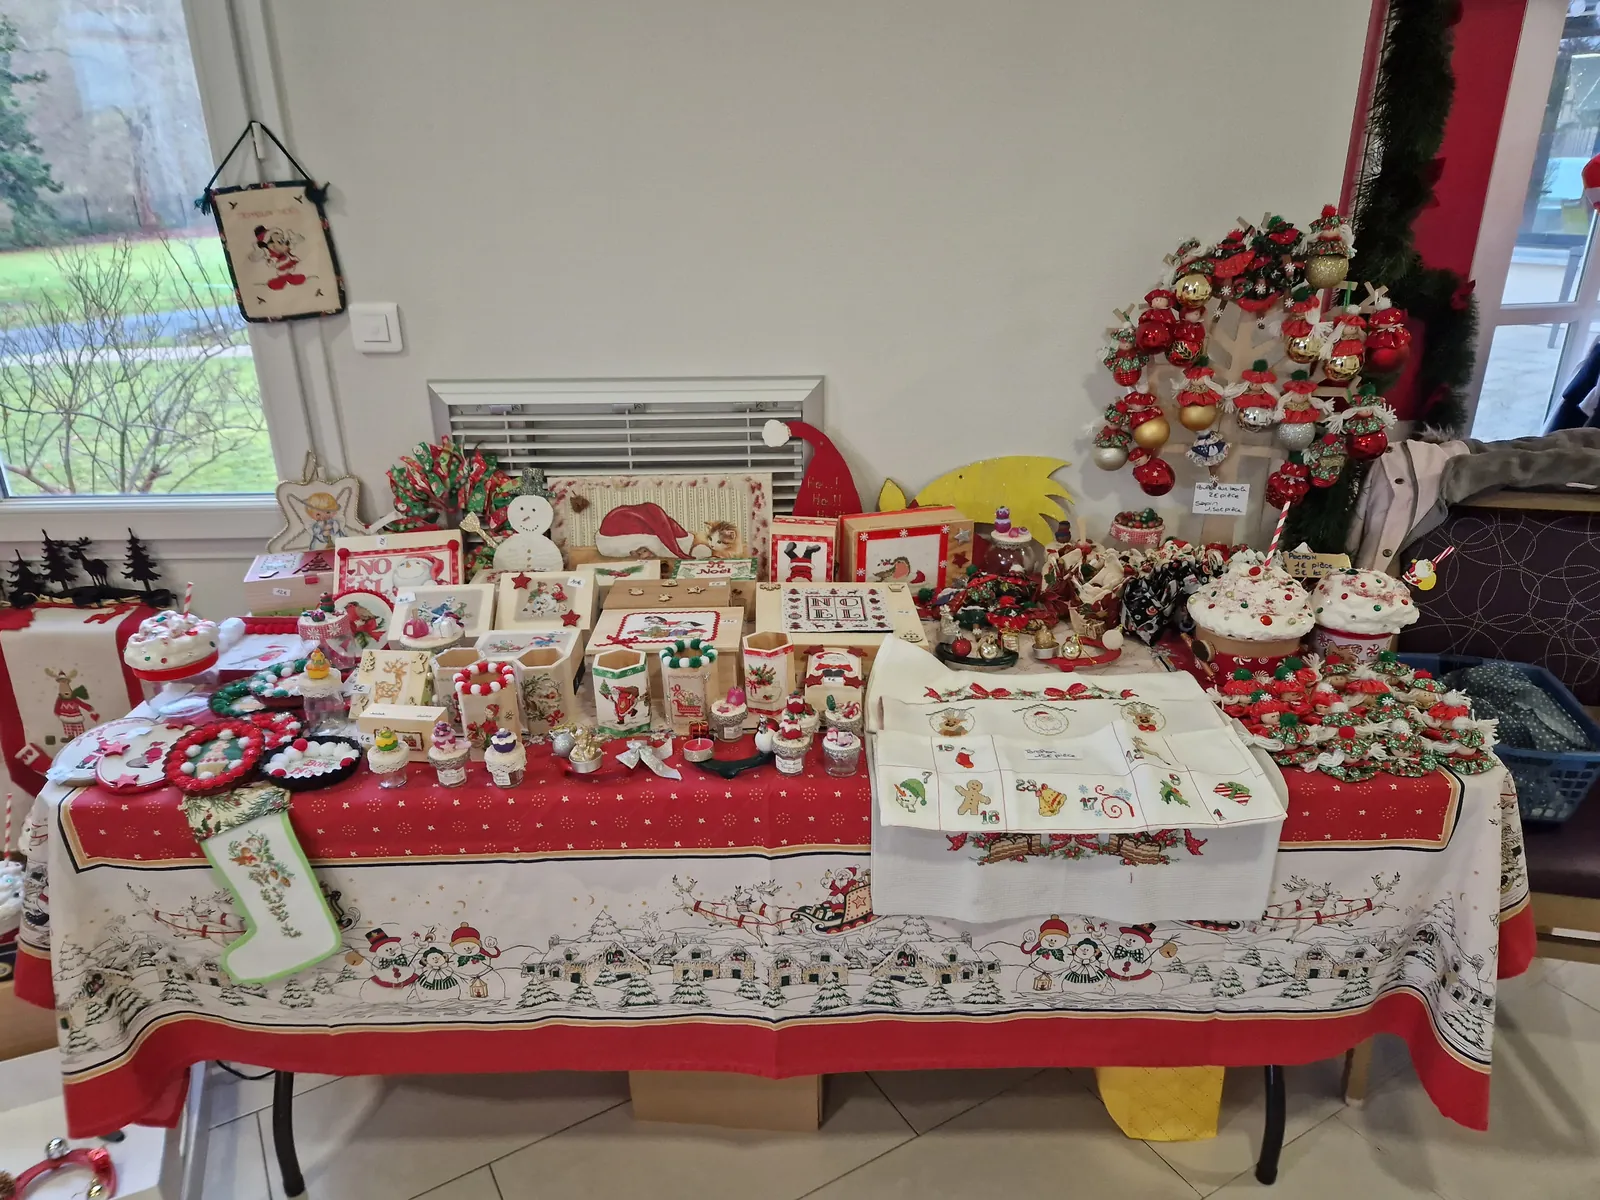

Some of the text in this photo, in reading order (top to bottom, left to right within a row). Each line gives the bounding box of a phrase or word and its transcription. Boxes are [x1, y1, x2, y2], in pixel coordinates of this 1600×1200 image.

[355, 558, 392, 577] NO
[1311, 562, 1333, 570] pièce
[353, 684, 365, 692] 5€
[1079, 796, 1098, 811] 17
